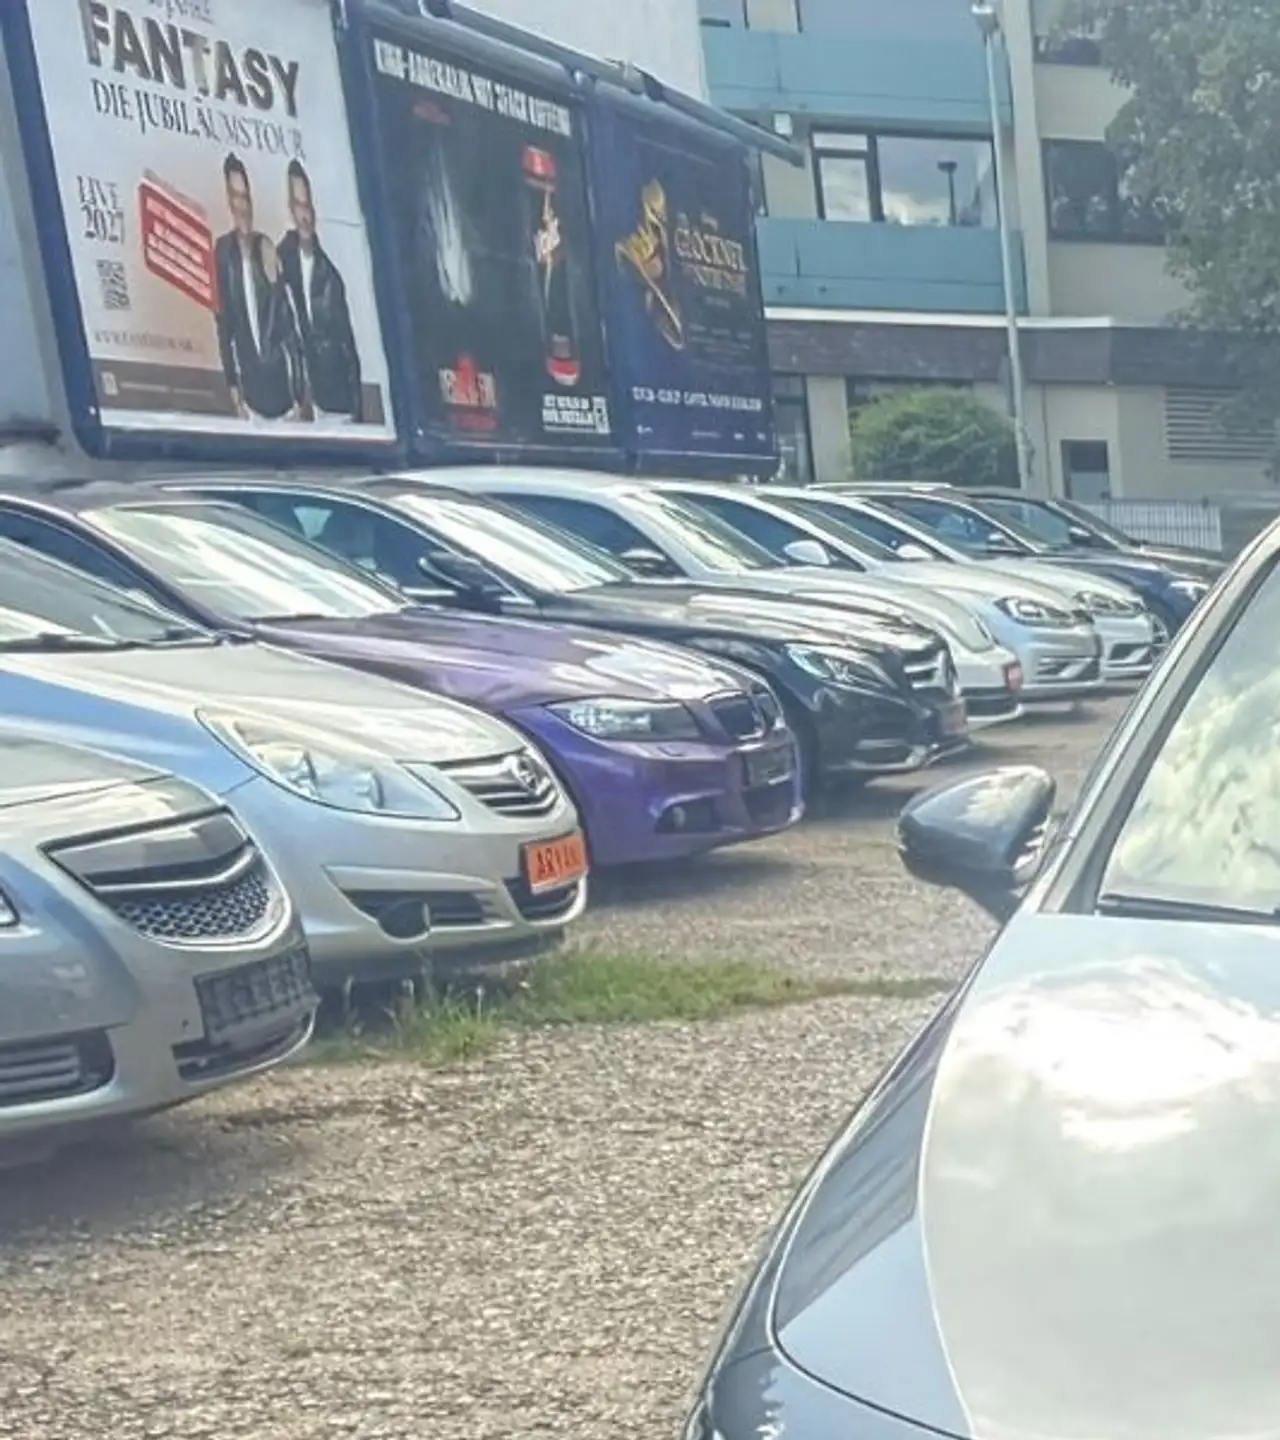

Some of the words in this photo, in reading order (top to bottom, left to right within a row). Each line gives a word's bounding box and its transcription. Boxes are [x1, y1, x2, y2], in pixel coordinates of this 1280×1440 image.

[79, 0, 299, 118] FANTASY
[91, 78, 133, 120] DIE
[77, 174, 119, 210] LIVE
